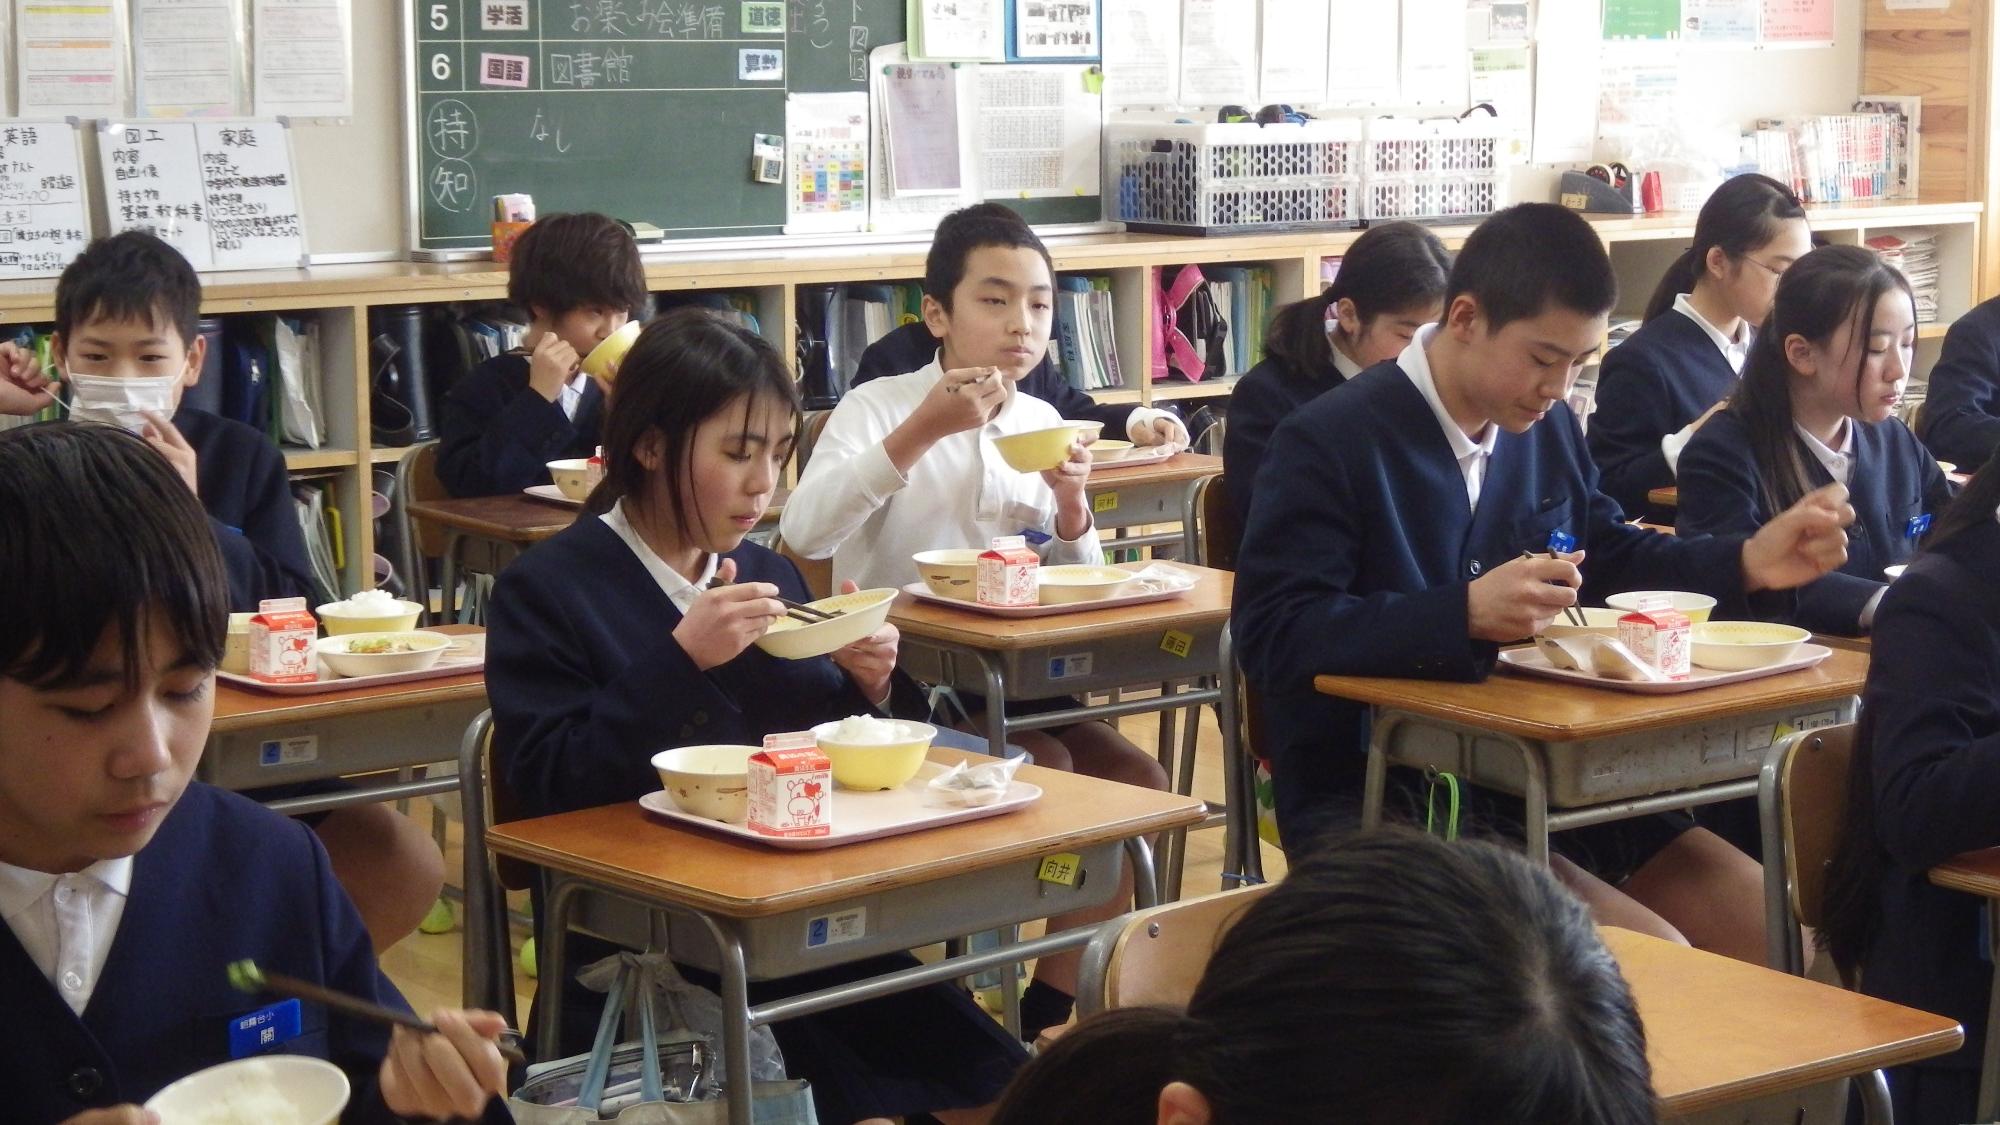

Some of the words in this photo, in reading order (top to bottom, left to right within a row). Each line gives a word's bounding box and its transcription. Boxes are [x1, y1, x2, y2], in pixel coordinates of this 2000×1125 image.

[430, 5, 448, 31] 5
[487, 5, 523, 26] 学活
[749, 6, 781, 27] 道徳
[431, 53, 450, 80] 6
[487, 57, 524, 82] 国語
[551, 47, 634, 89] 図書館
[745, 53, 777, 74] 算数
[4, 126, 38, 146] 英語
[125, 129, 165, 144] 図工
[219, 127, 258, 148] 家庭
[431, 105, 472, 153] 持
[530, 107, 572, 153] なし
[112, 148, 139, 164] 内容
[433, 163, 471, 207] 知
[1044, 859, 1071, 880] 向井
[813, 920, 824, 938] 2
